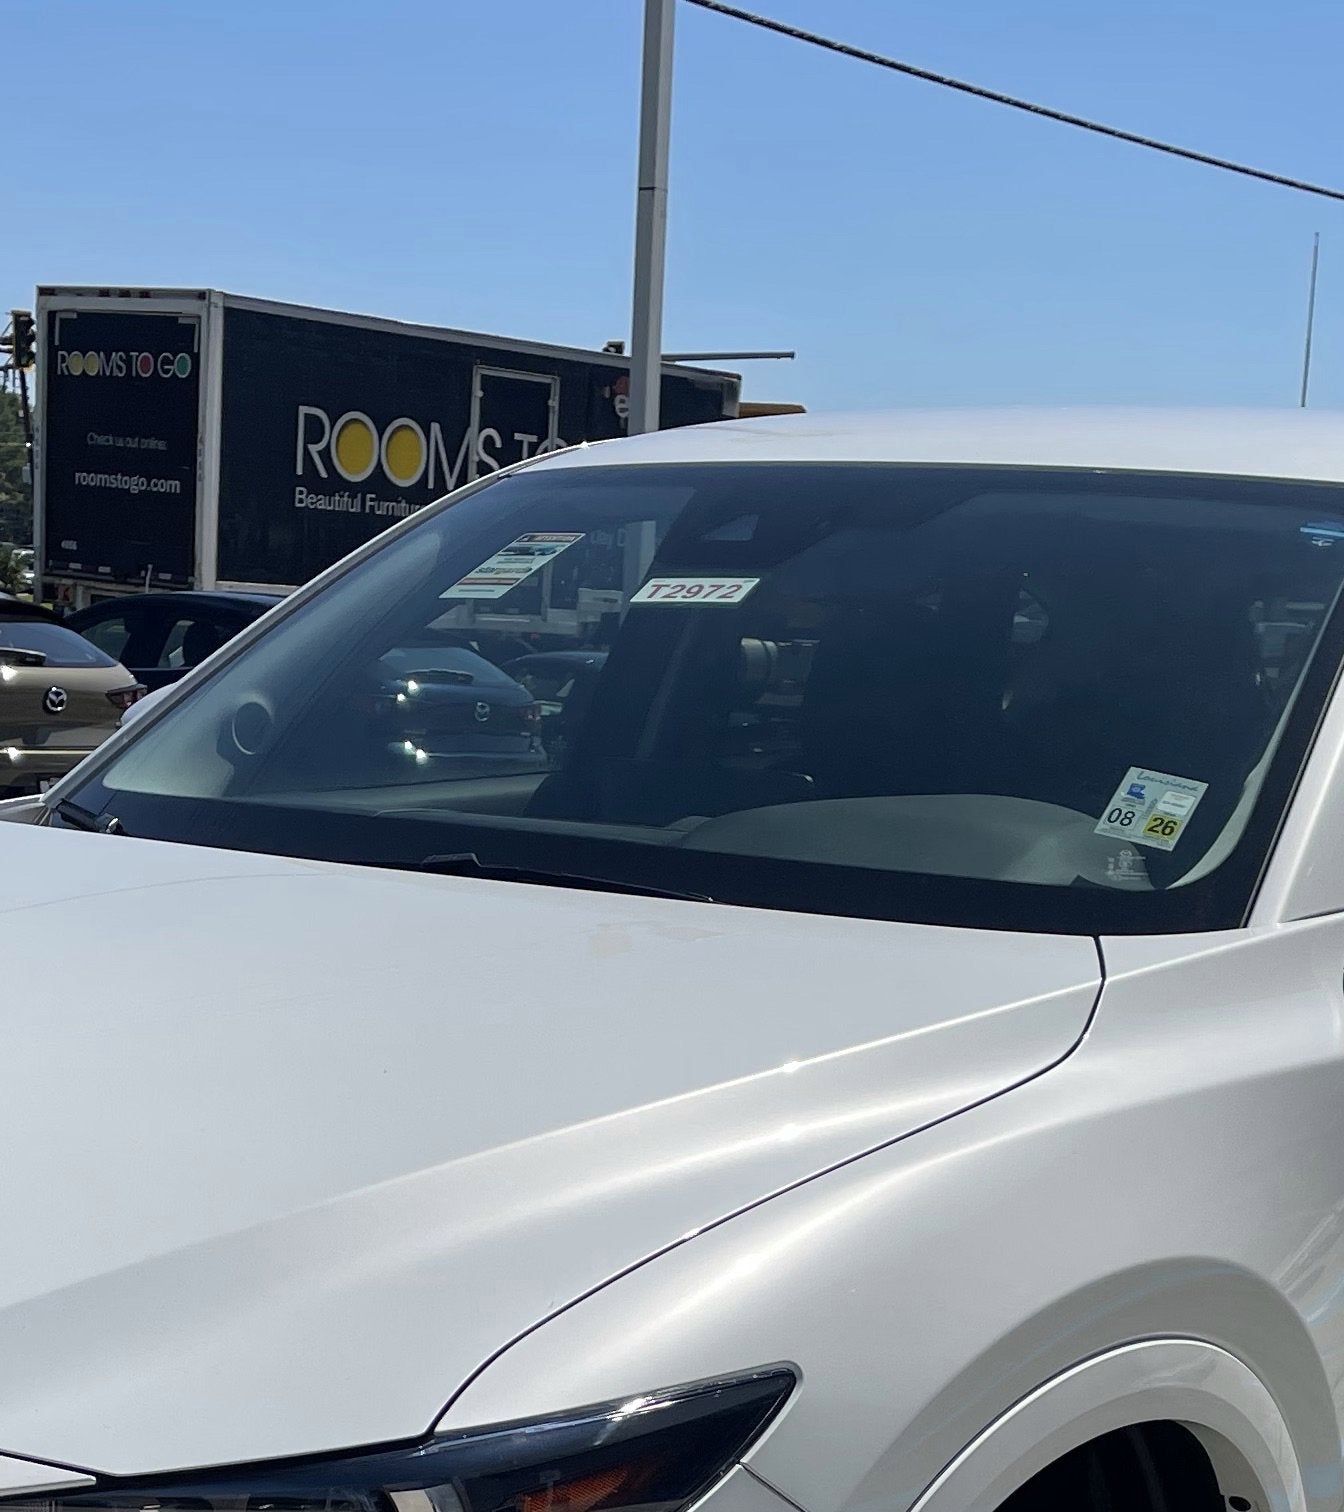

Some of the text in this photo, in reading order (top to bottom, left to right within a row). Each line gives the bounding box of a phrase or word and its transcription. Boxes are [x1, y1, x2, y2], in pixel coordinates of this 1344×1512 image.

[57, 351, 191, 378] ROOMS TO GO
[87, 432, 113, 445] Check
[295, 405, 502, 490] ROOMS
[75, 472, 181, 493] roomstogo.com
[295, 486, 361, 513] Beautiful
[646, 584, 742, 599] T2972
[1107, 807, 1178, 837] 08 26
